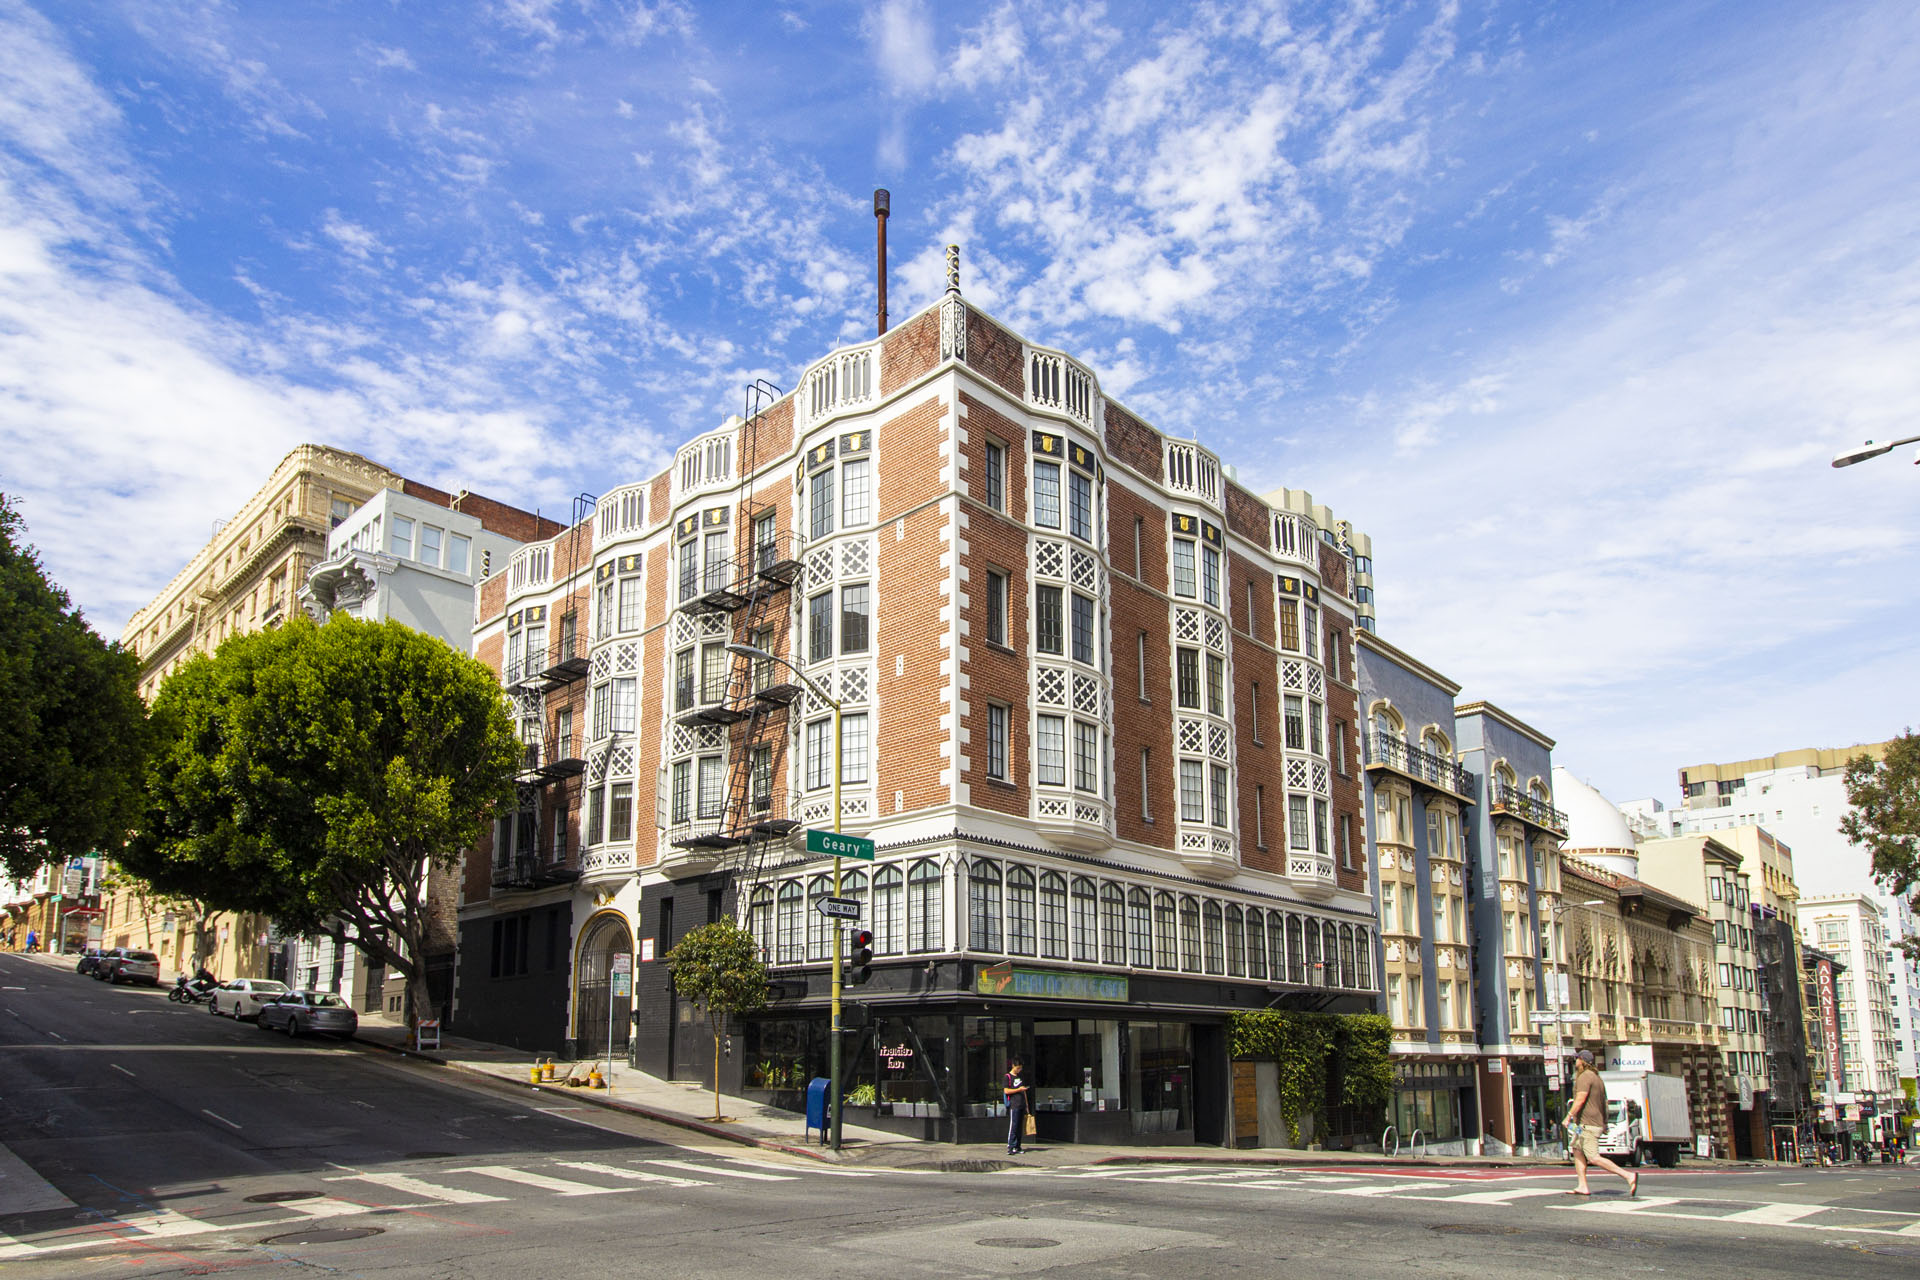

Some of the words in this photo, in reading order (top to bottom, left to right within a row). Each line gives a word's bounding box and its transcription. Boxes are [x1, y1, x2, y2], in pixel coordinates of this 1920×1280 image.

[822, 836, 860, 857] Geary
[828, 903, 841, 912] ONE
[842, 905, 856, 914] WAY
[1819, 965, 1833, 1026] ADANTE
[1826, 1031, 1838, 1081] HOTEL
[1612, 1058, 1647, 1066] Alcazar
